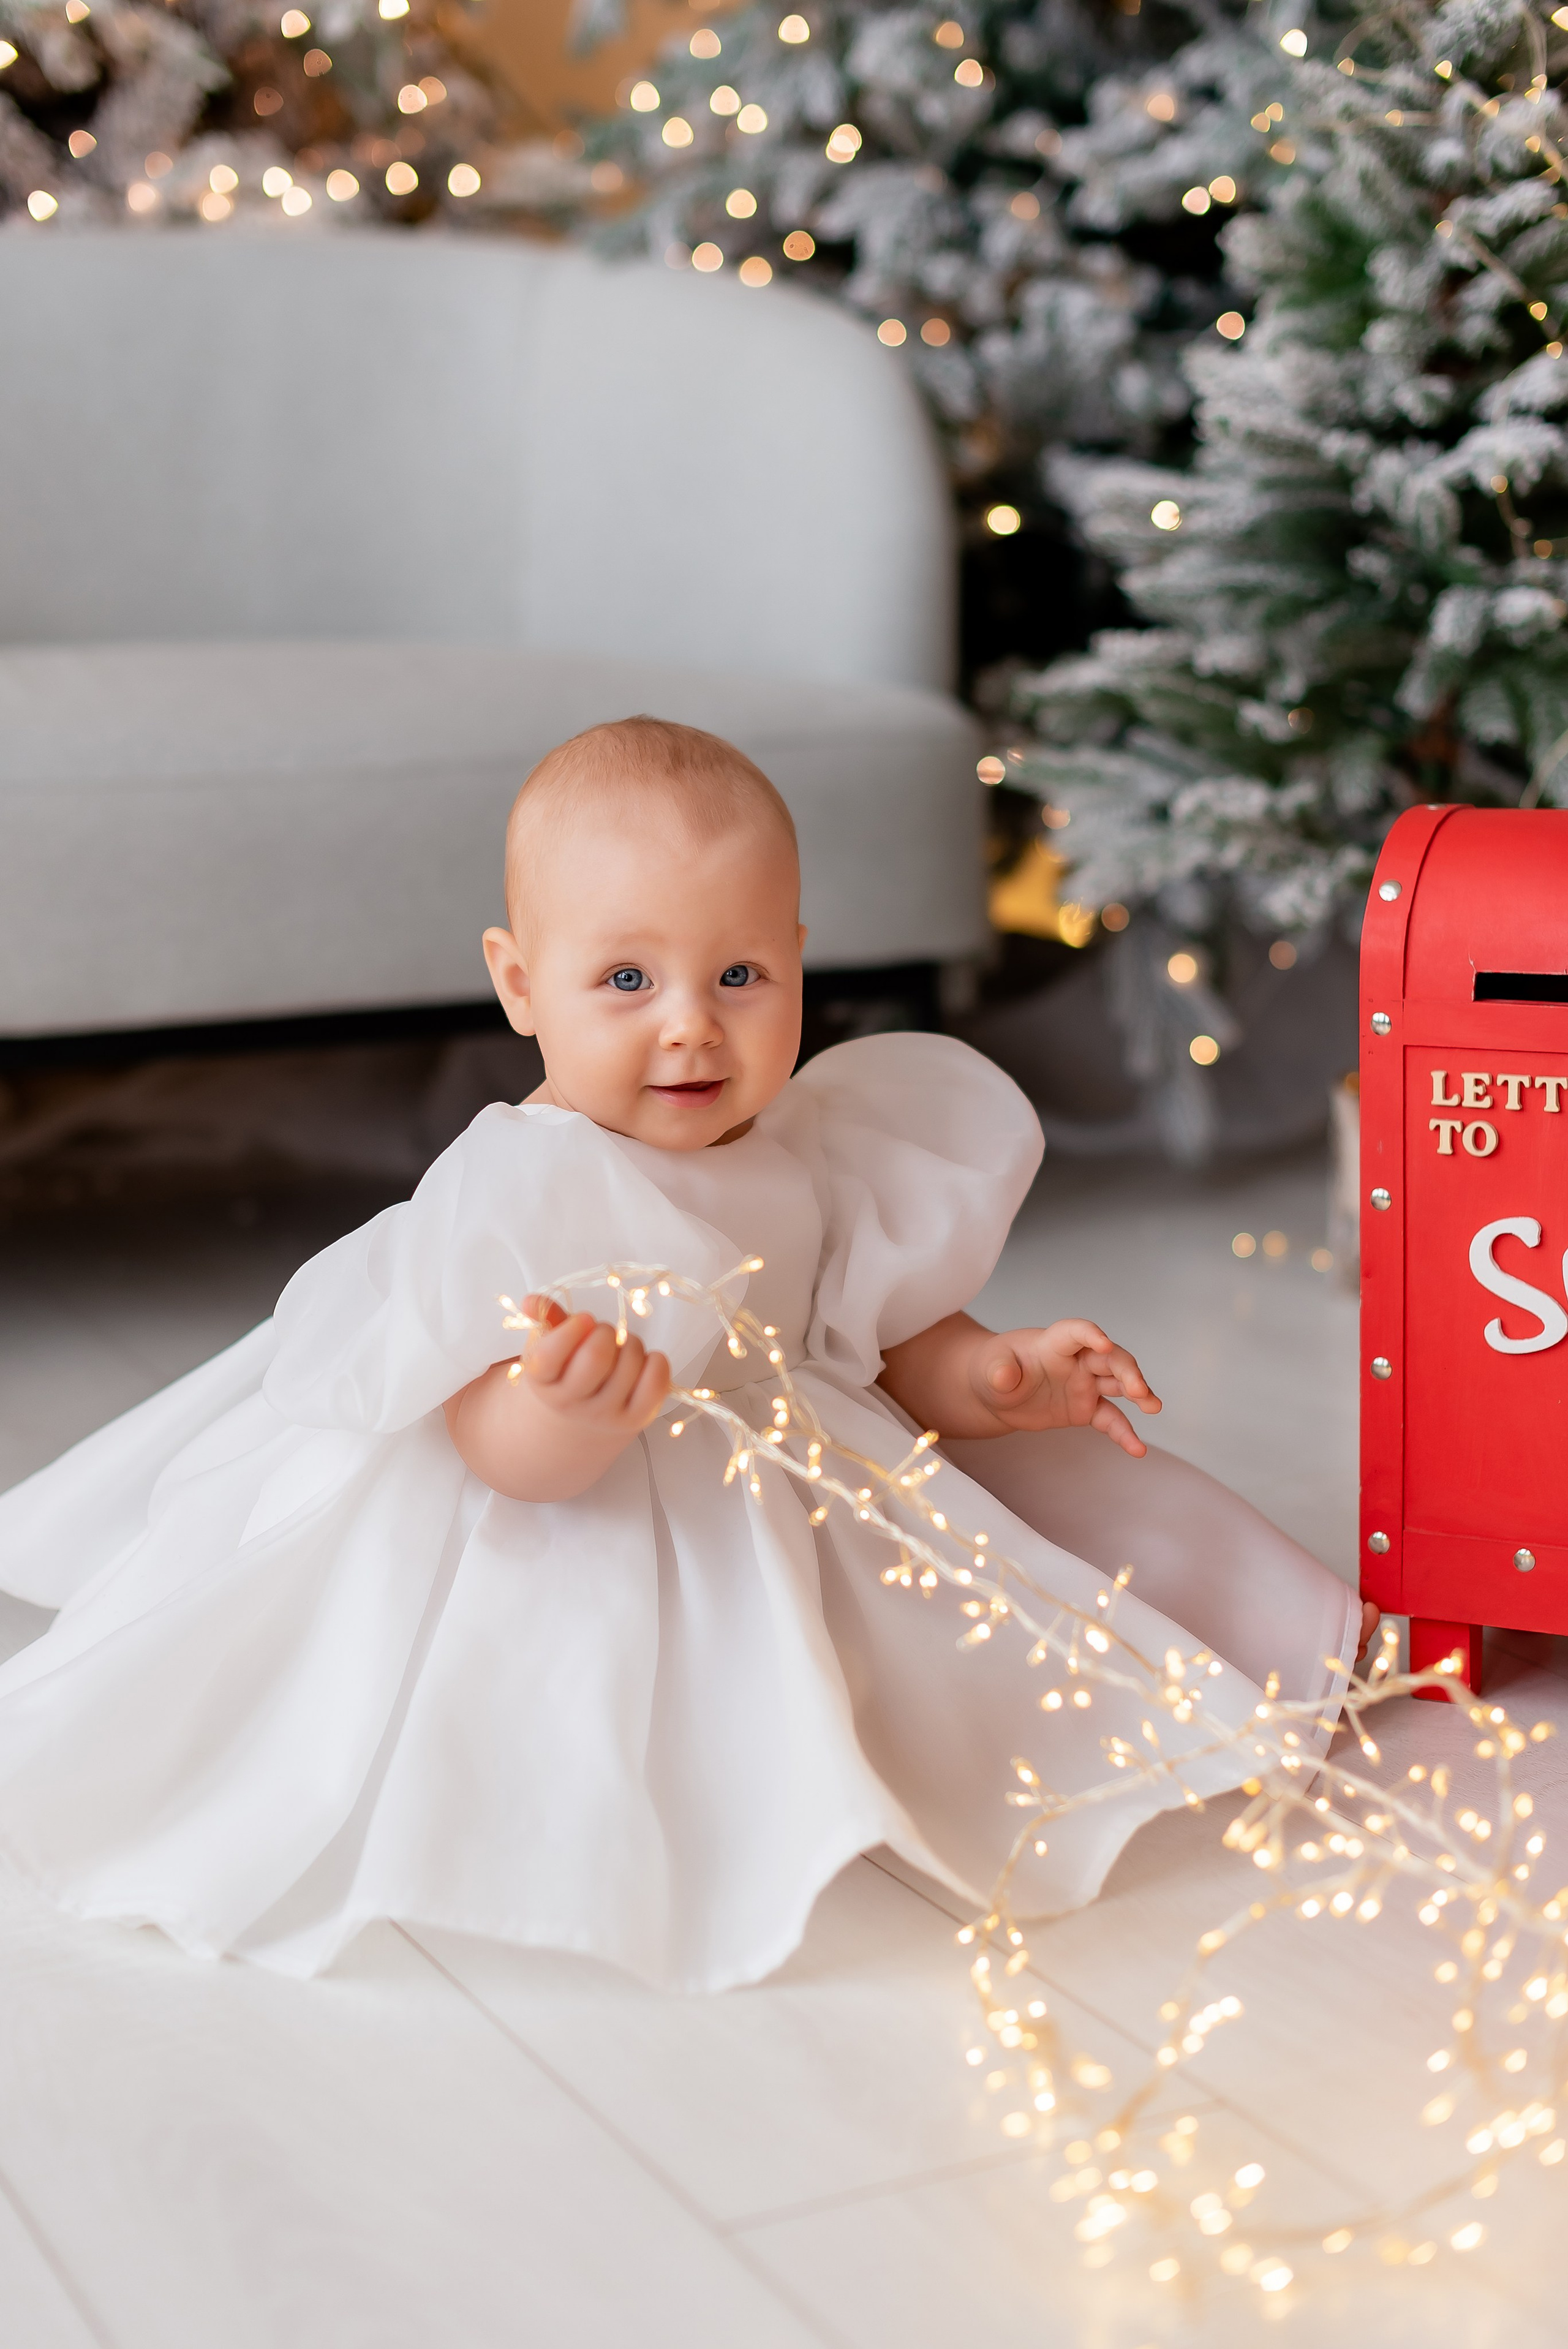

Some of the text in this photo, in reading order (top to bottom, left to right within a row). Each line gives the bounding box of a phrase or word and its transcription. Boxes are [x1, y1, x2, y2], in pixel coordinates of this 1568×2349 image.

[1430, 1069, 1568, 1113] LETT
[1428, 1118, 1499, 1158] TO
[1469, 1216, 1568, 1355] S
